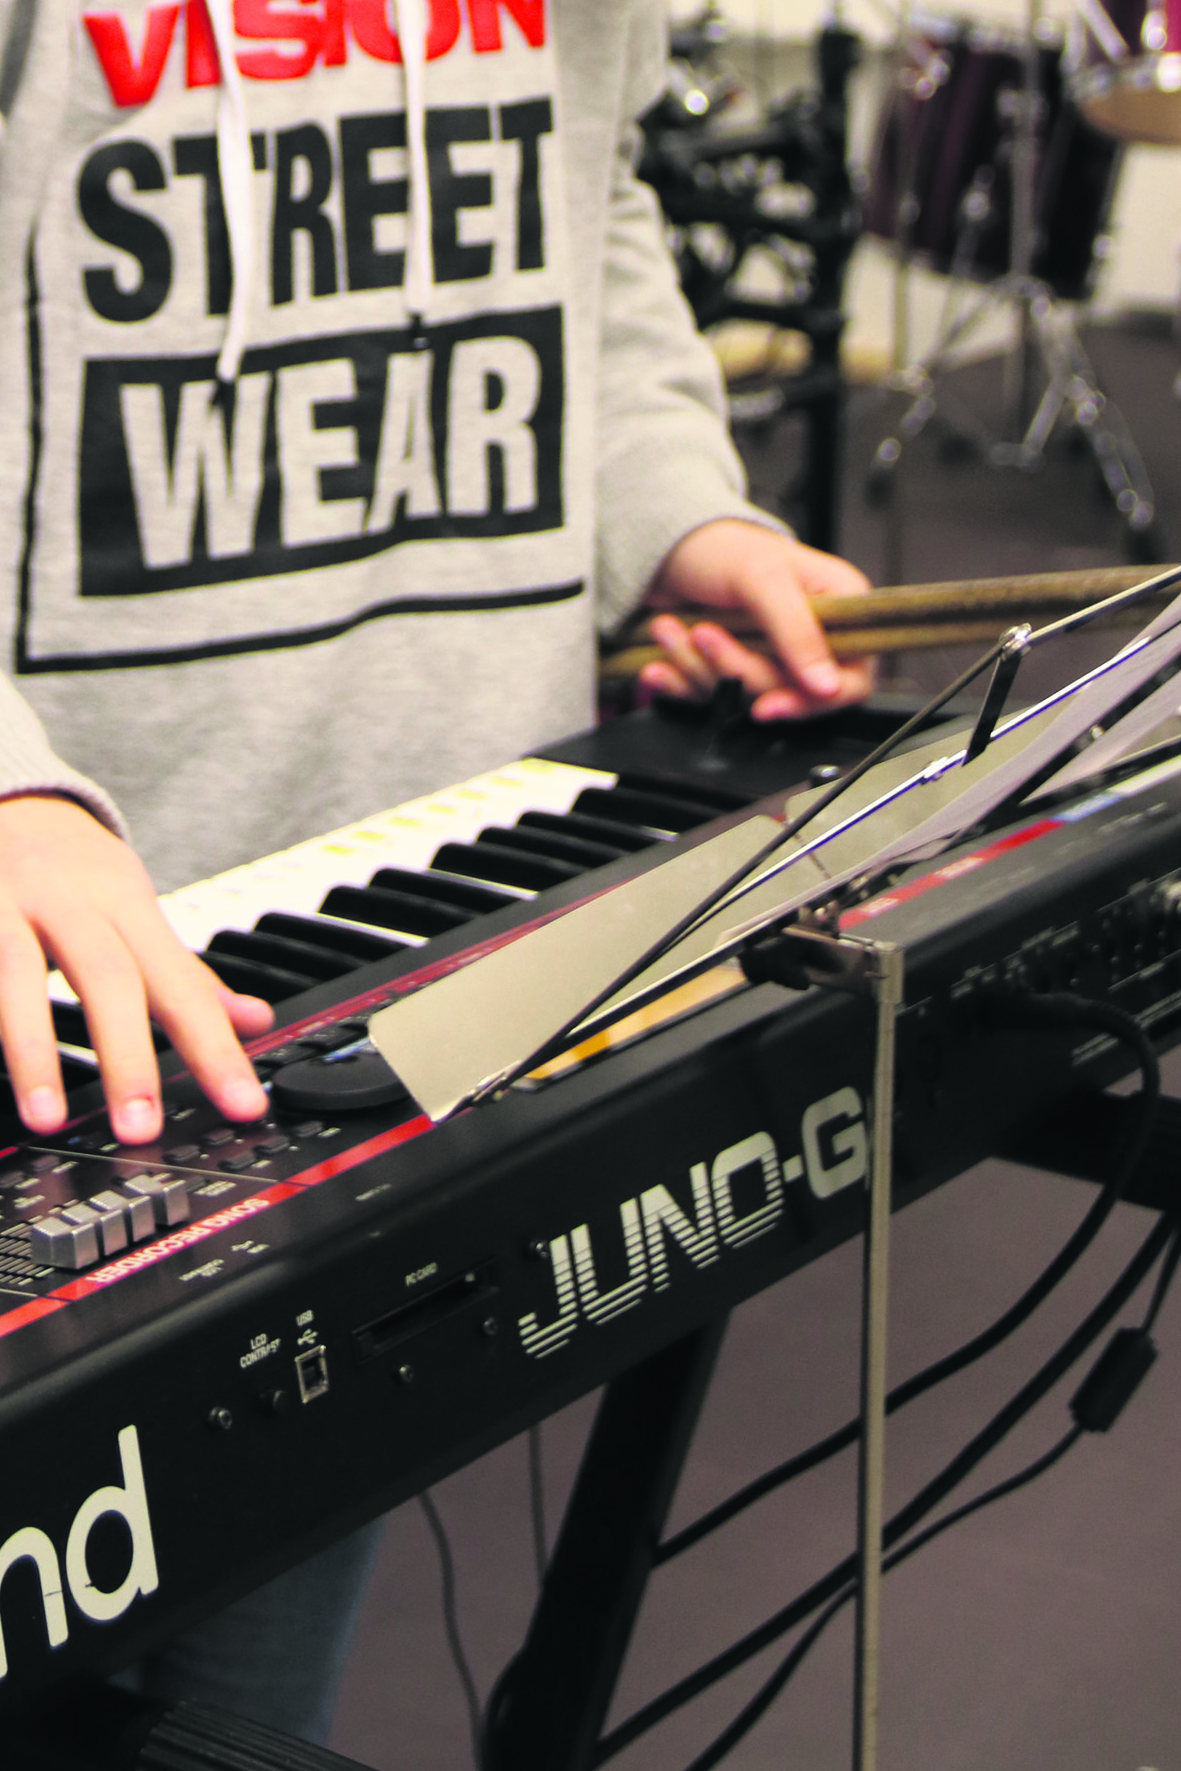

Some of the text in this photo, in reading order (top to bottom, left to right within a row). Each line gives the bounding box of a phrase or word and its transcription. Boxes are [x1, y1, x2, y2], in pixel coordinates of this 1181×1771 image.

[76, 96, 555, 323] STREET
[120, 335, 542, 570] WEAR
[86, 1217, 208, 1284] RECORDER
[205, 1197, 269, 1229] SONG
[517, 1085, 868, 1360] JUNO-G
